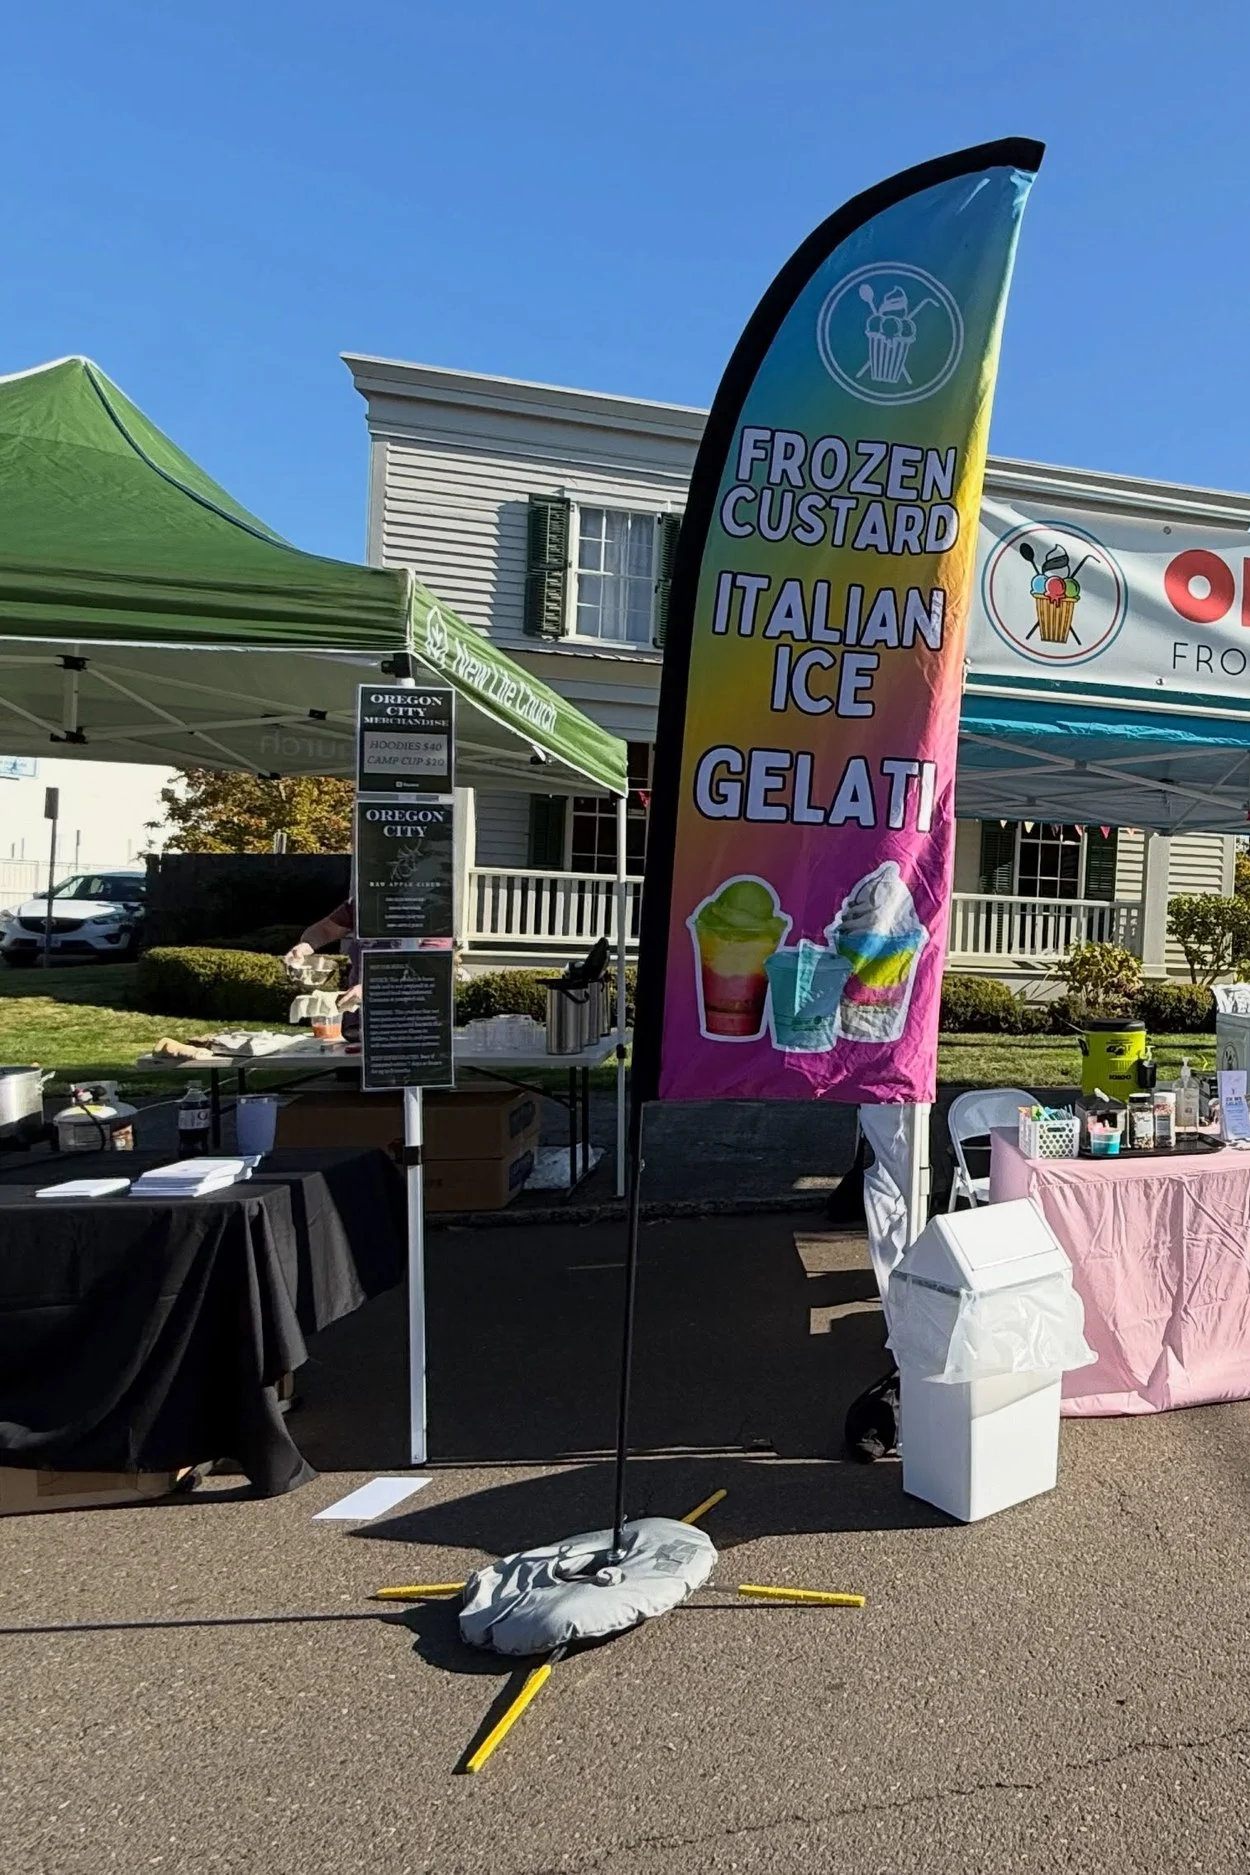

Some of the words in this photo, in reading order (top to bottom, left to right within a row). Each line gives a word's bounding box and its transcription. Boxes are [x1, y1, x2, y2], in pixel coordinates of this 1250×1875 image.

[735, 426, 957, 501] FROZEN
[720, 484, 959, 555] CUSTARD
[713, 571, 945, 650] ITALIAN
[452, 638, 489, 692] New
[516, 682, 557, 734] Church
[770, 643, 879, 718] ICE
[370, 694, 443, 705] OREGON
[386, 707, 426, 716] CITY
[364, 717, 449, 726] MERCHANDISE
[370, 741, 420, 750] HOODIES
[423, 742, 442, 751] $40
[367, 756, 399, 764] CAMP
[401, 757, 423, 765] CUP
[425, 758, 444, 766] $20
[694, 745, 937, 833] GELATI
[366, 809, 444, 822] OREGON
[384, 825, 427, 837] CITY
